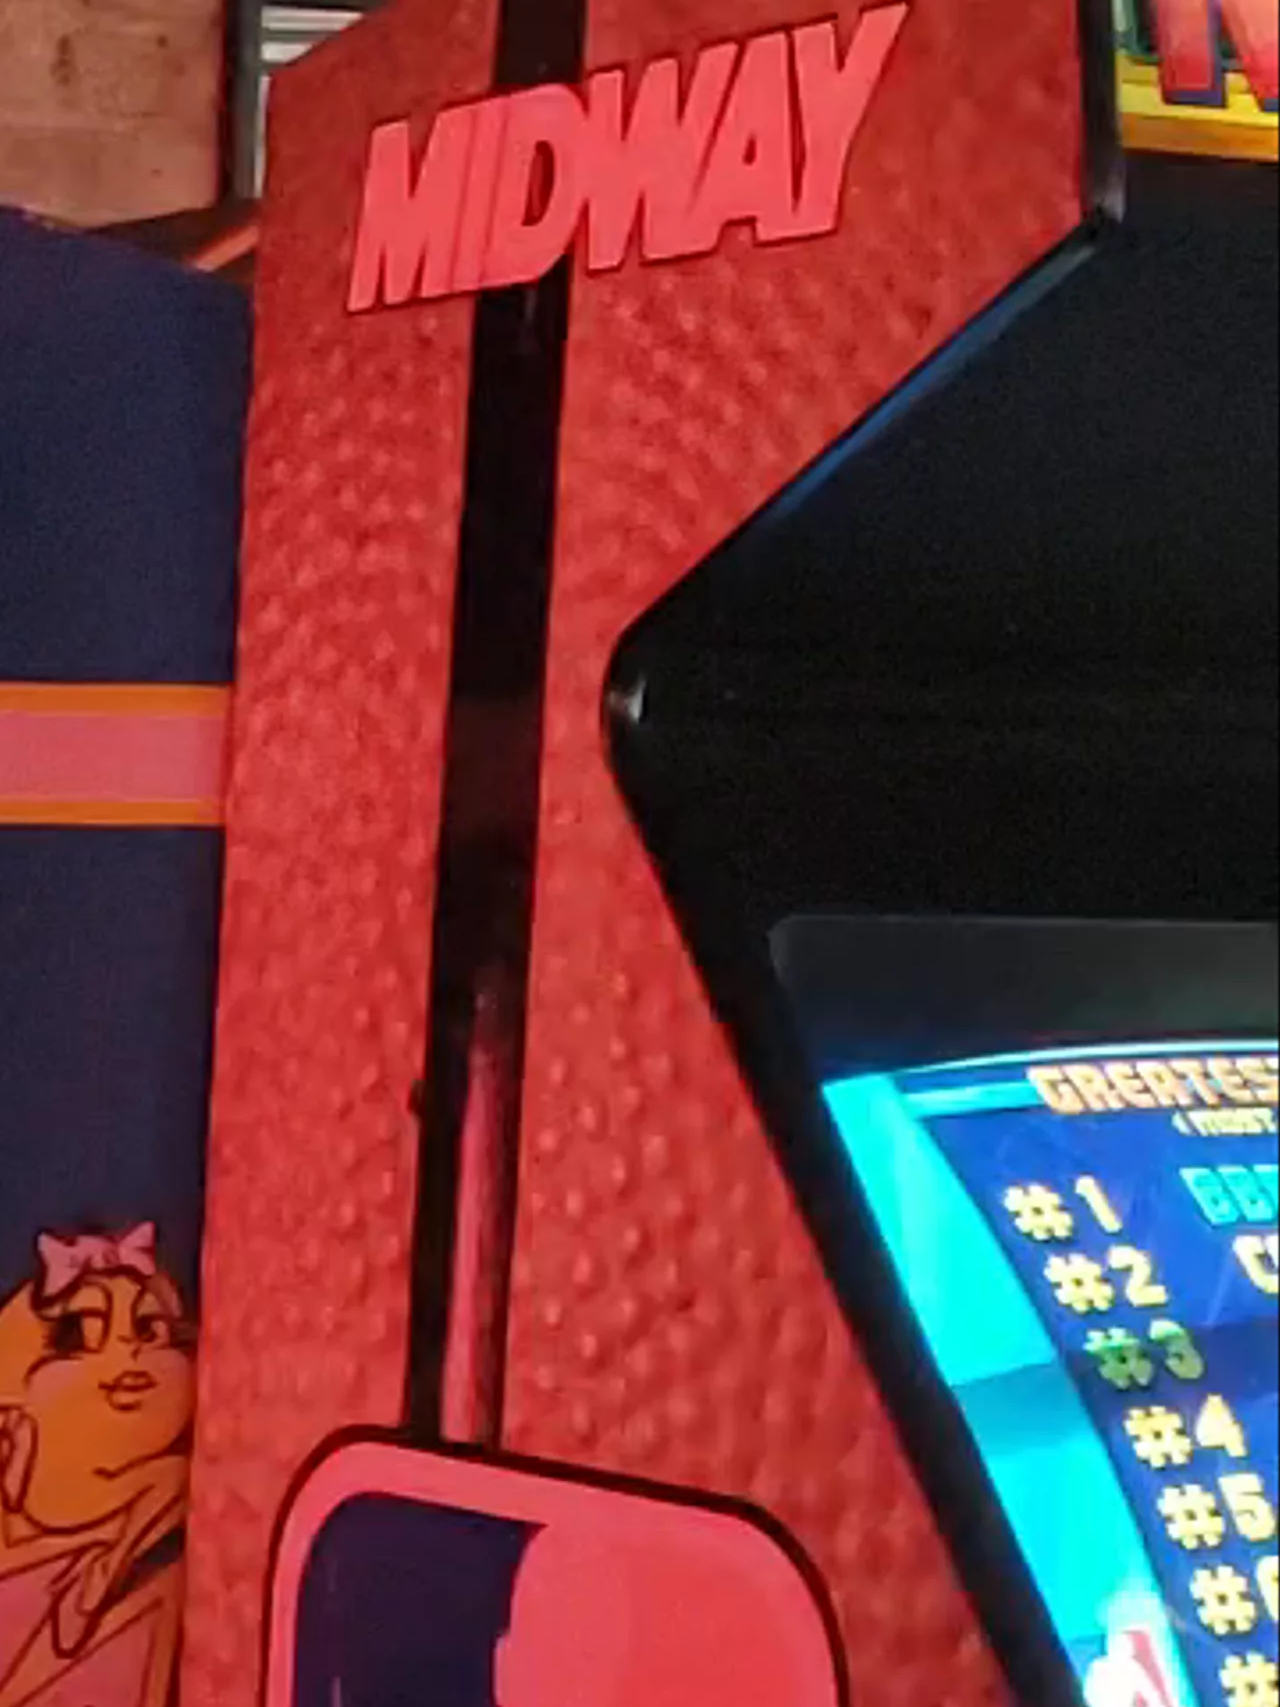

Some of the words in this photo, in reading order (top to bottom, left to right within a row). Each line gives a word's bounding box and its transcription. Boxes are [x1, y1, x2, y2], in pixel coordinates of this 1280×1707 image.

[346, 1, 911, 315] MIDWAY
[1027, 1056, 1279, 1116] GREATES
[1003, 1174, 1123, 1242] #1
[1043, 1244, 1169, 1313] #2
[1083, 1319, 1204, 1388] #3
[1124, 1394, 1247, 1469] #4
[1157, 1471, 1276, 1551] #5
